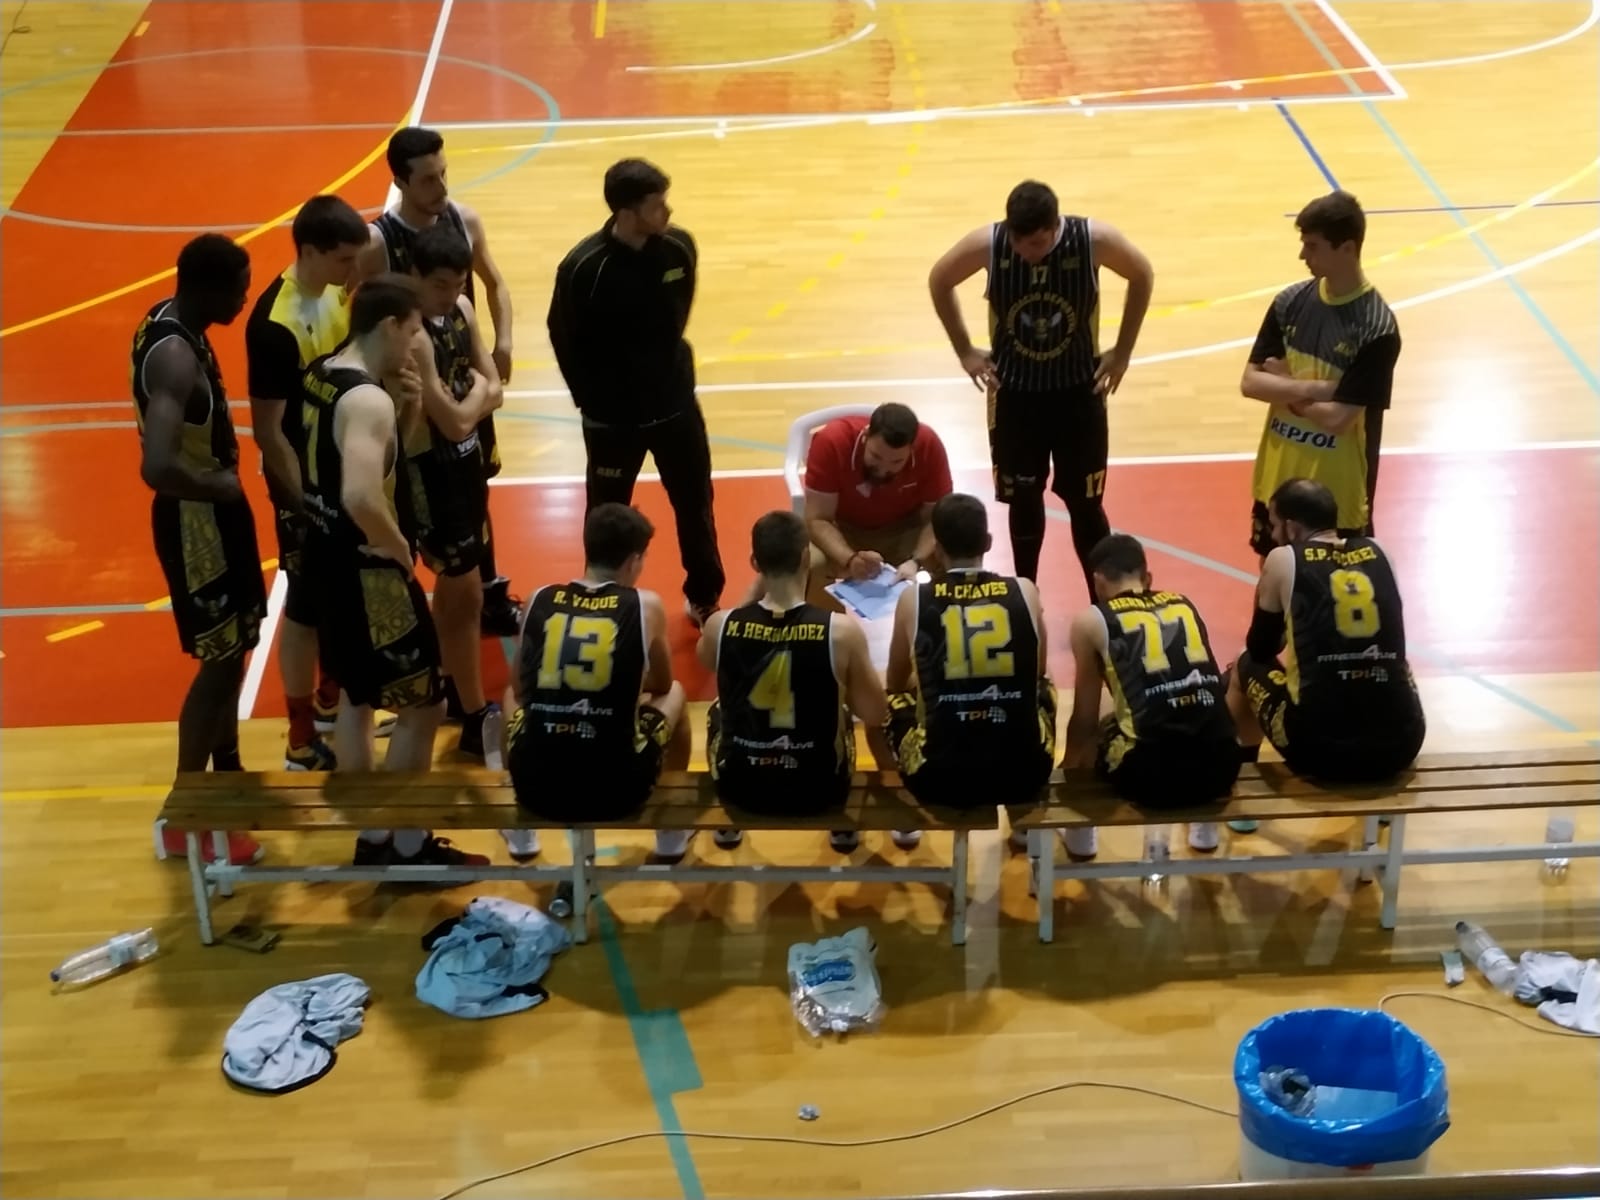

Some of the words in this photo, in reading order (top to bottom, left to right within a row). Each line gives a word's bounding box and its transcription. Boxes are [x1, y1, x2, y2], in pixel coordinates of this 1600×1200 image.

[1270, 417, 1337, 449] REPSOL
[1085, 469, 1105, 498] 17
[934, 582, 952, 598] M.
[954, 581, 1008, 599] CHAVES
[1329, 568, 1381, 638] 8
[537, 612, 619, 692] 13
[726, 620, 740, 638] M.
[940, 602, 1015, 680] 12
[1116, 603, 1209, 673] 77
[748, 649, 796, 729] 4
